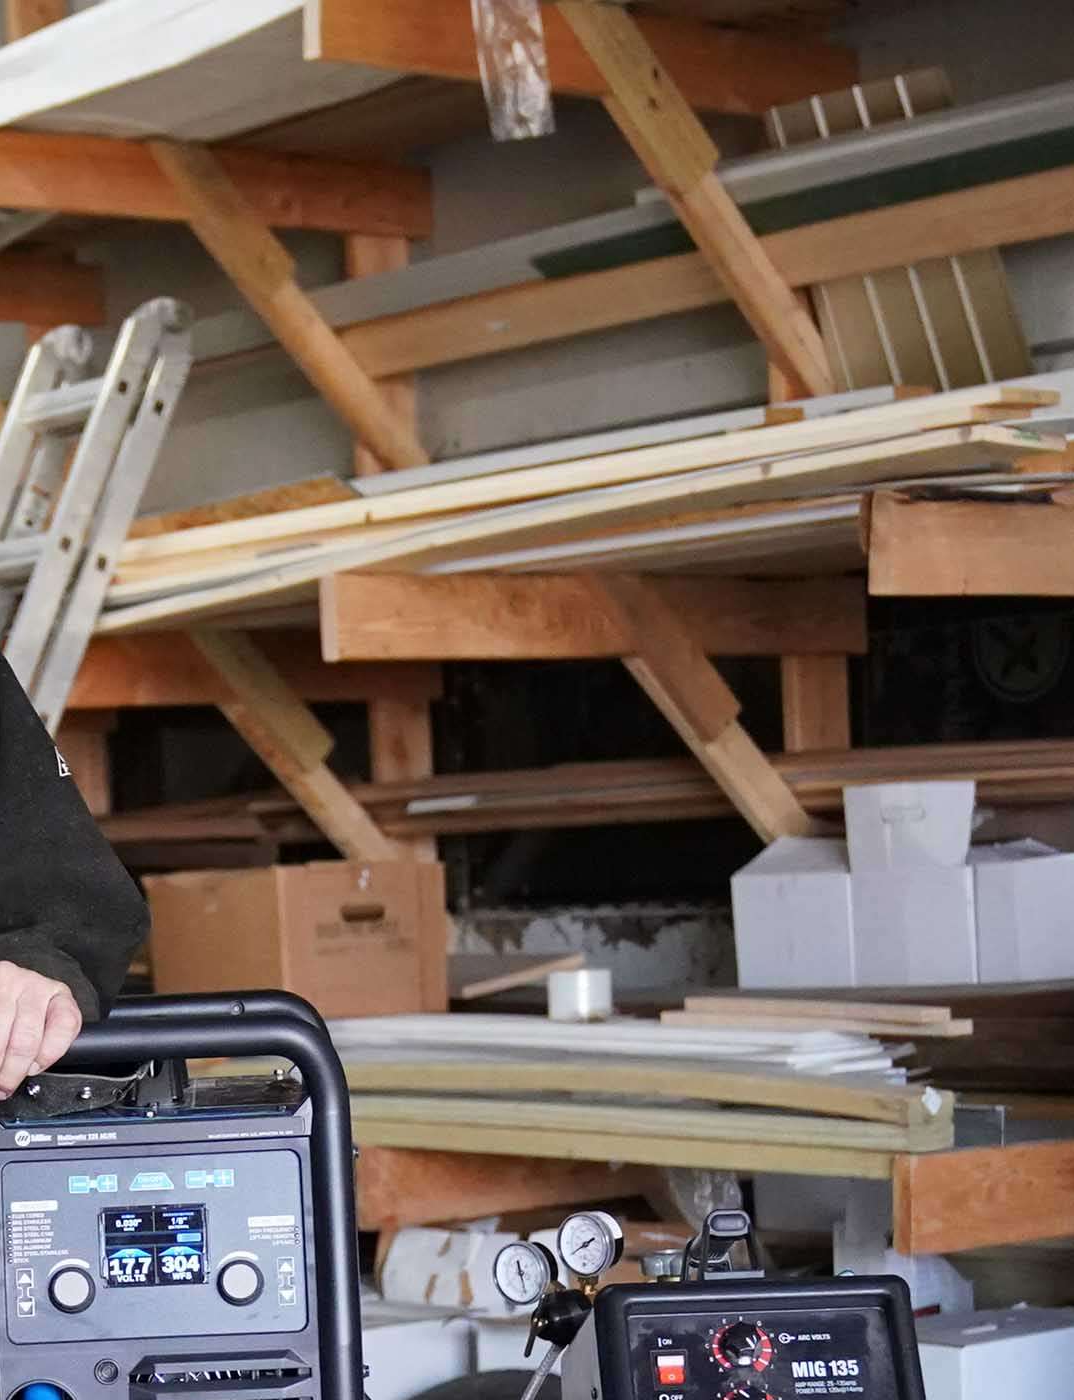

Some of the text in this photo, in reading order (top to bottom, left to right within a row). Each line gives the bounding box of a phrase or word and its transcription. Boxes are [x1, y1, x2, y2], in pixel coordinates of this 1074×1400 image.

[109, 1257, 153, 1276] 17.7
[161, 1254, 201, 1274] 304
[117, 1273, 147, 1283] VOLTS
[791, 1359, 860, 1378] MIG 135
